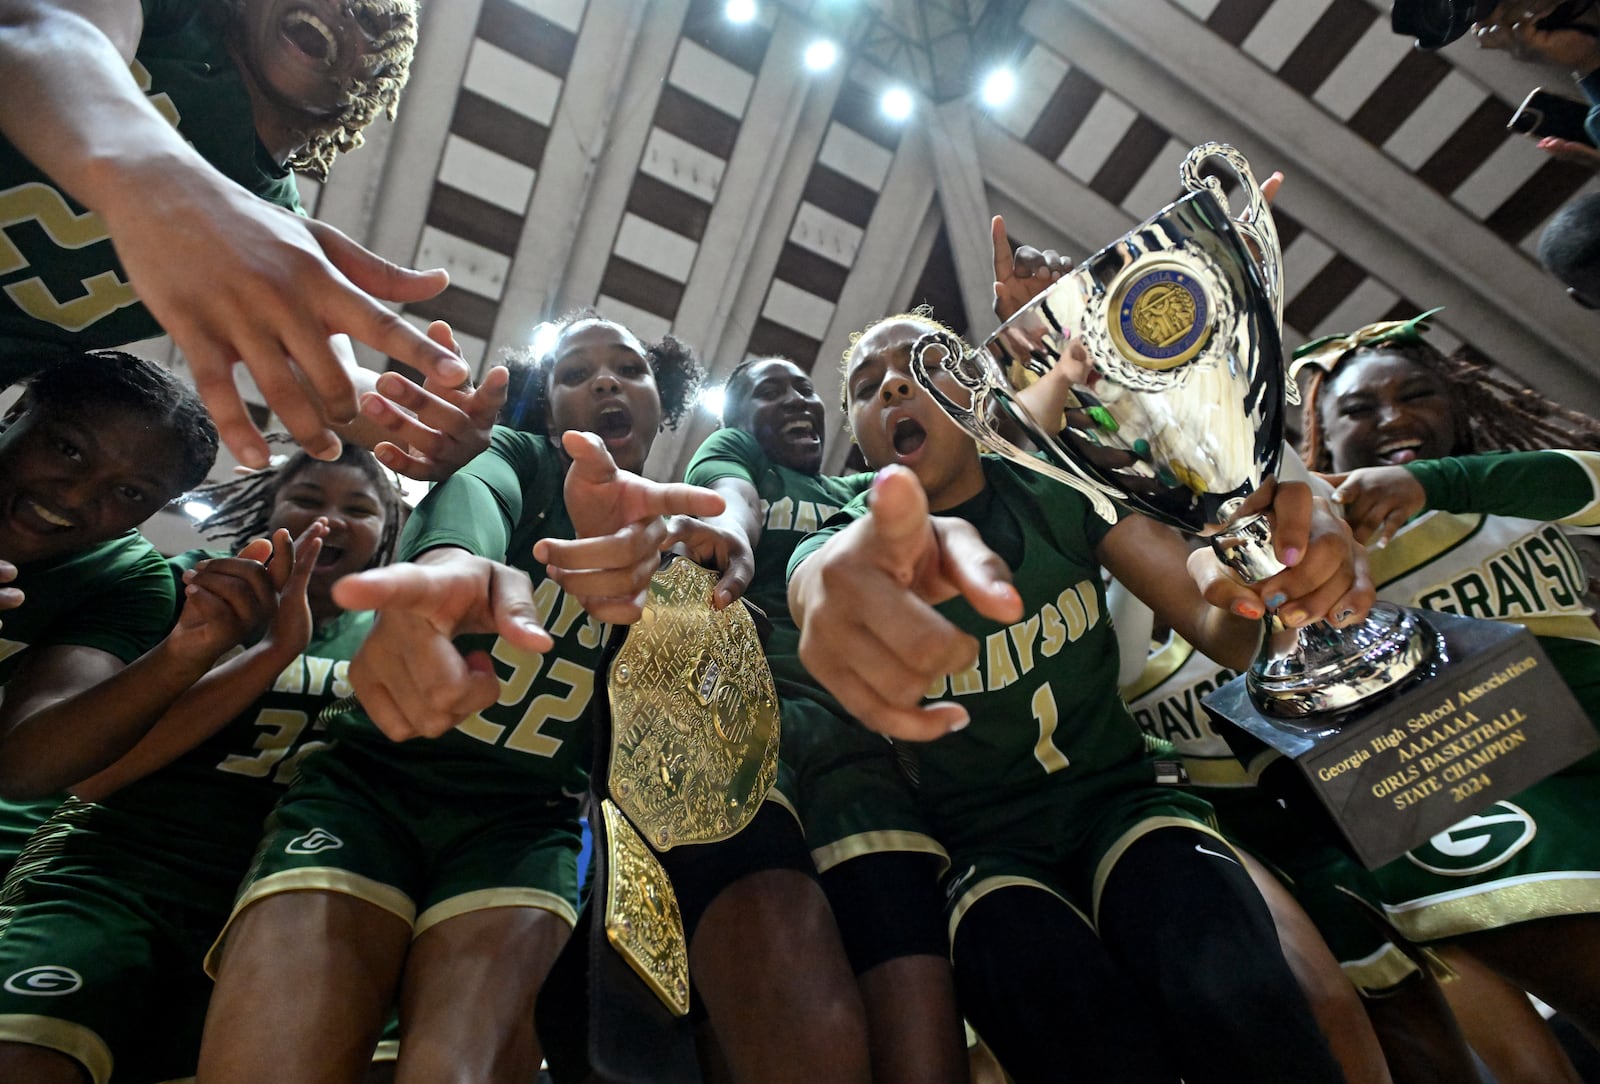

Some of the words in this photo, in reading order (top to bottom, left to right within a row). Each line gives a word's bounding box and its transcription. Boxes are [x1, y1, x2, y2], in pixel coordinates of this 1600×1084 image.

[455, 632, 596, 758] 22
[1031, 681, 1070, 774] 1
[1317, 750, 1372, 782] Georgia
[1370, 728, 1407, 754] High
[1407, 703, 1456, 733] School
[1458, 656, 1538, 704] Association
[1397, 711, 1480, 764] AAAAAAA
[1371, 765, 1421, 800] GIRLS
[1423, 707, 1527, 772] BASKETBALL
[1393, 777, 1440, 811] STATE
[1442, 729, 1527, 782] CHAMPION
[1448, 774, 1492, 804] 2024
